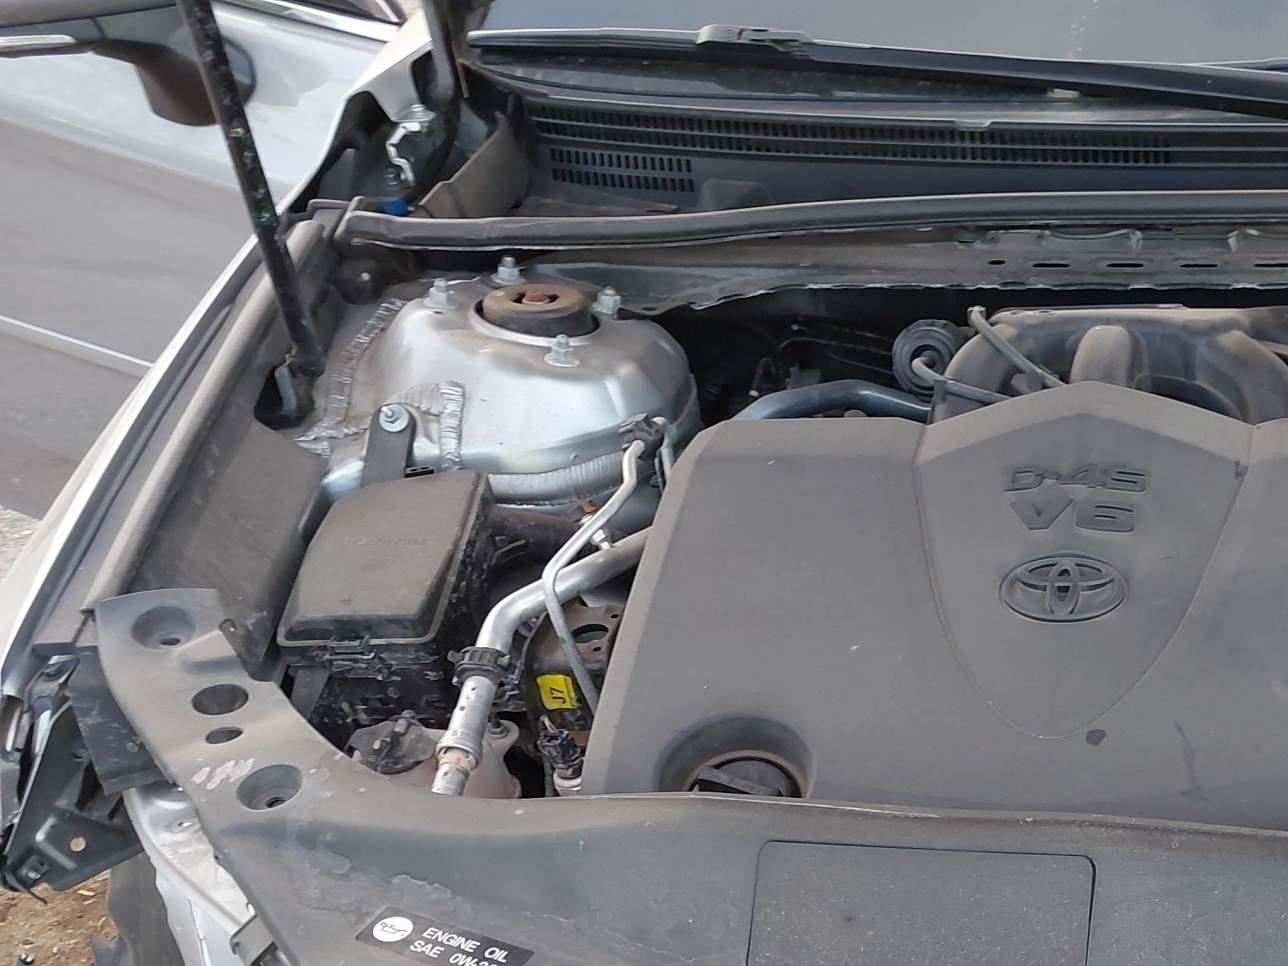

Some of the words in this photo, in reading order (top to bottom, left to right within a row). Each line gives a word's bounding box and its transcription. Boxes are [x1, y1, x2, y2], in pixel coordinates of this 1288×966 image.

[1008, 499, 1137, 534] V6
[549, 687, 566, 704] J7
[410, 940, 444, 958] SAE
[423, 927, 480, 952] ENGINE
[484, 947, 509, 963] OIL
